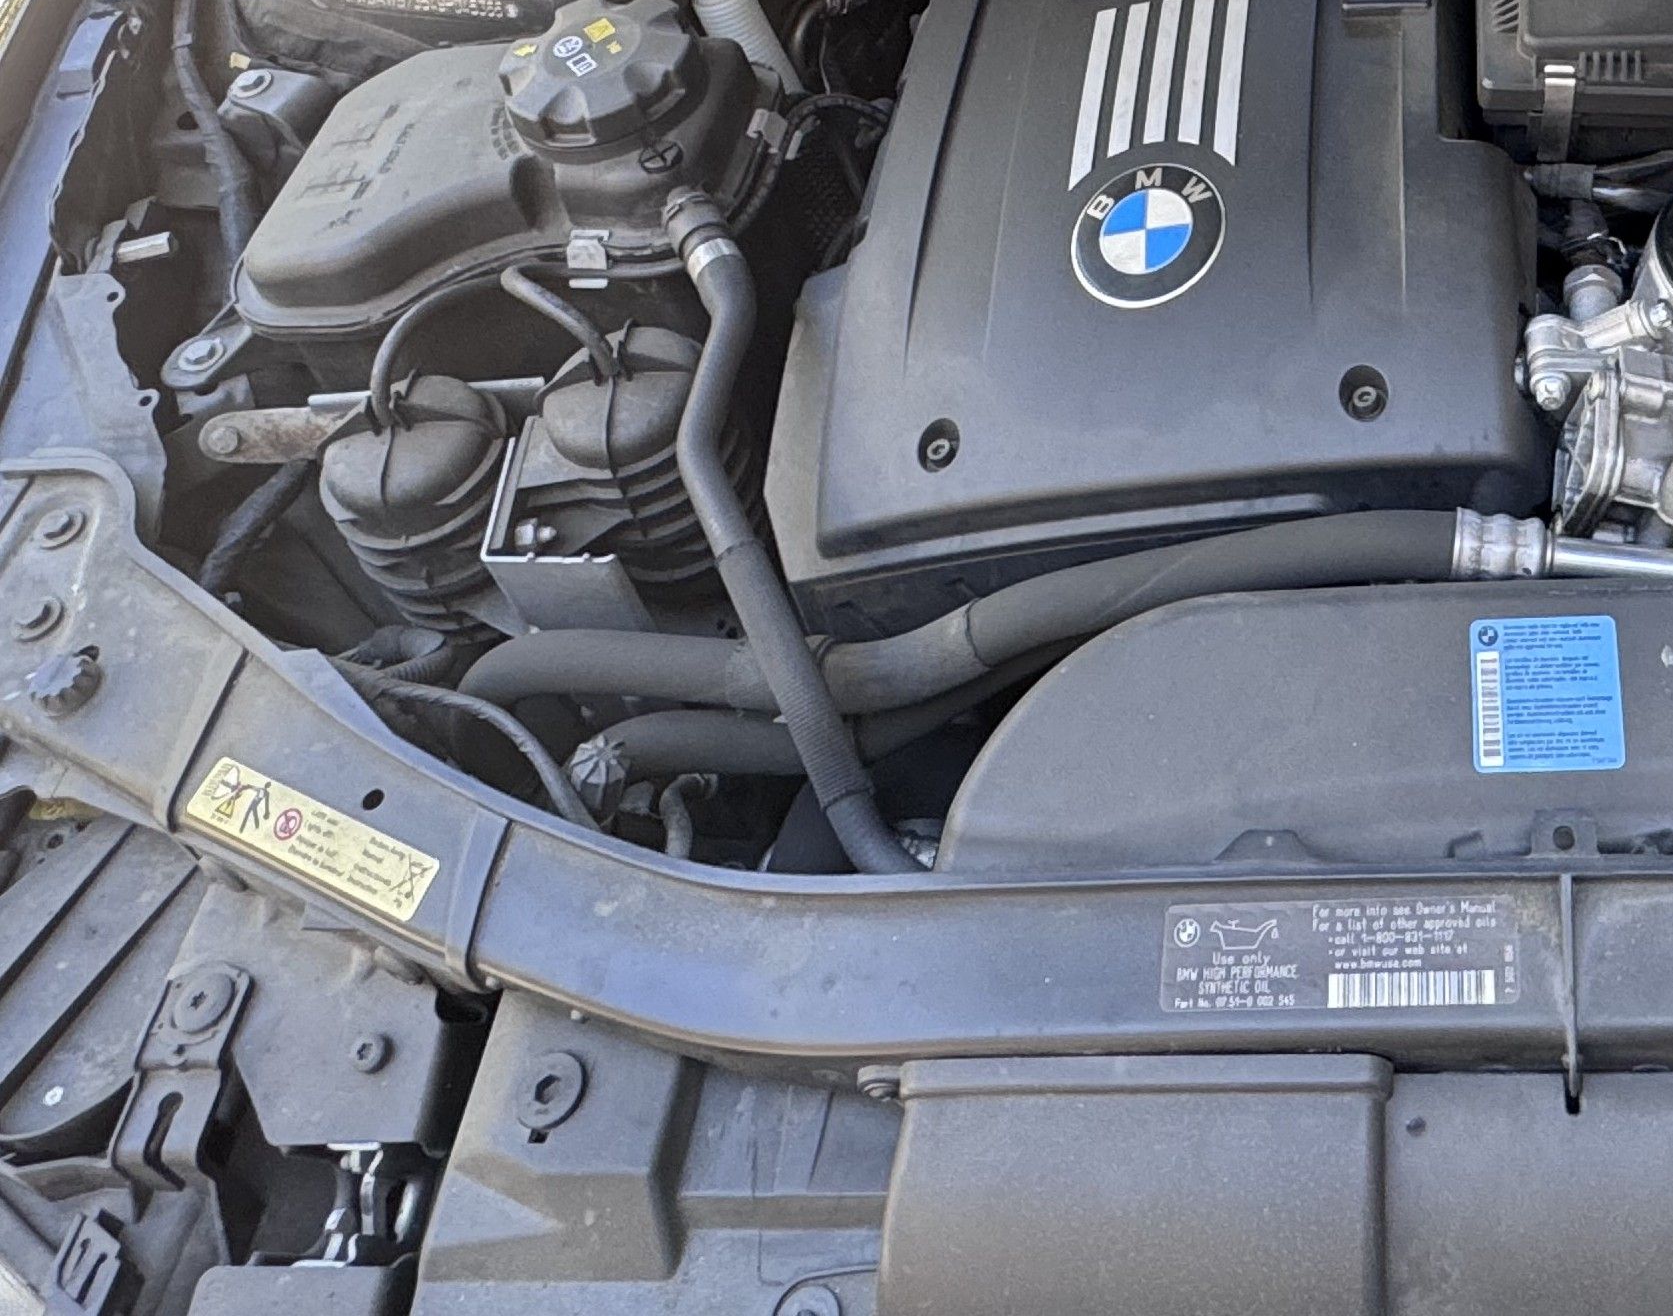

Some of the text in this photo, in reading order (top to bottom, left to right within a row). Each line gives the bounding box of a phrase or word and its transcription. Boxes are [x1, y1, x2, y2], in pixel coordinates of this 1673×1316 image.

[1086, 167, 1213, 220] BMW
[1312, 904, 1330, 918] For
[1335, 907, 1360, 918] more
[1312, 918, 1330, 932] For
[1372, 916, 1385, 931] of
[1212, 950, 1271, 967] Use only
[1176, 964, 1298, 982] BMW HIGH PERFORMANCE
[1198, 979, 1271, 995] SYNTHETIC OIL
